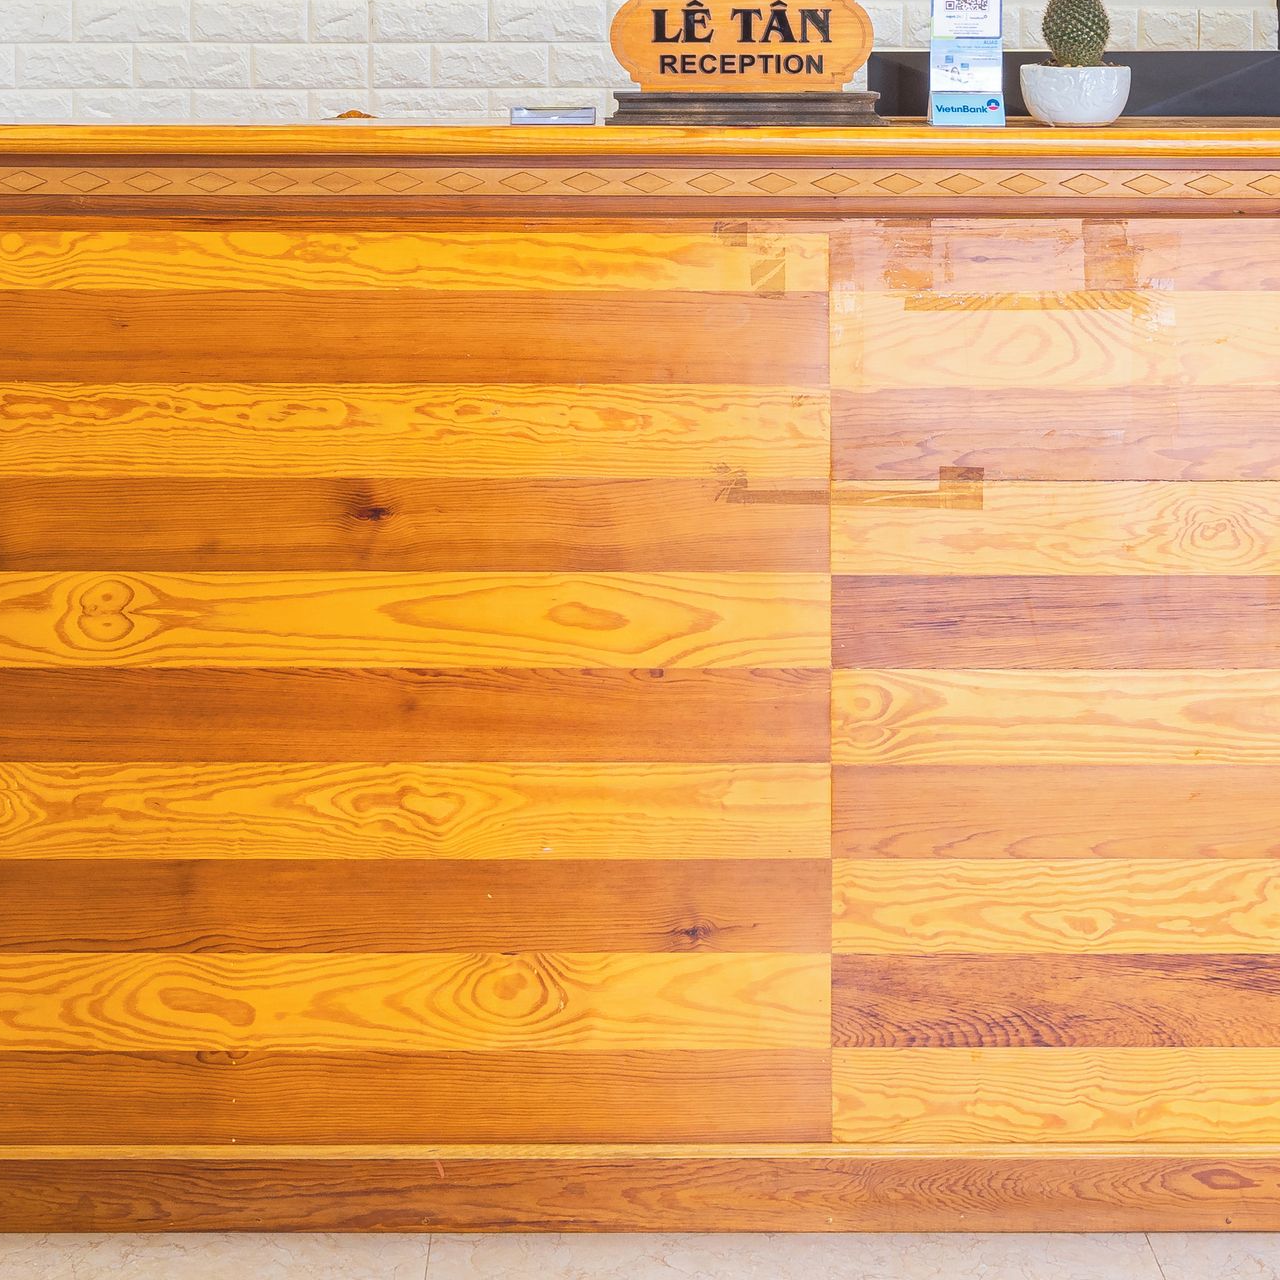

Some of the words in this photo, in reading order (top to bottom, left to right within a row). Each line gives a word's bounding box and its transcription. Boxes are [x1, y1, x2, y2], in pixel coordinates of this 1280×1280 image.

[730, 0, 832, 43] TÂN
[659, 54, 824, 74] RECEPTION
[935, 105, 988, 114] VietinBank
